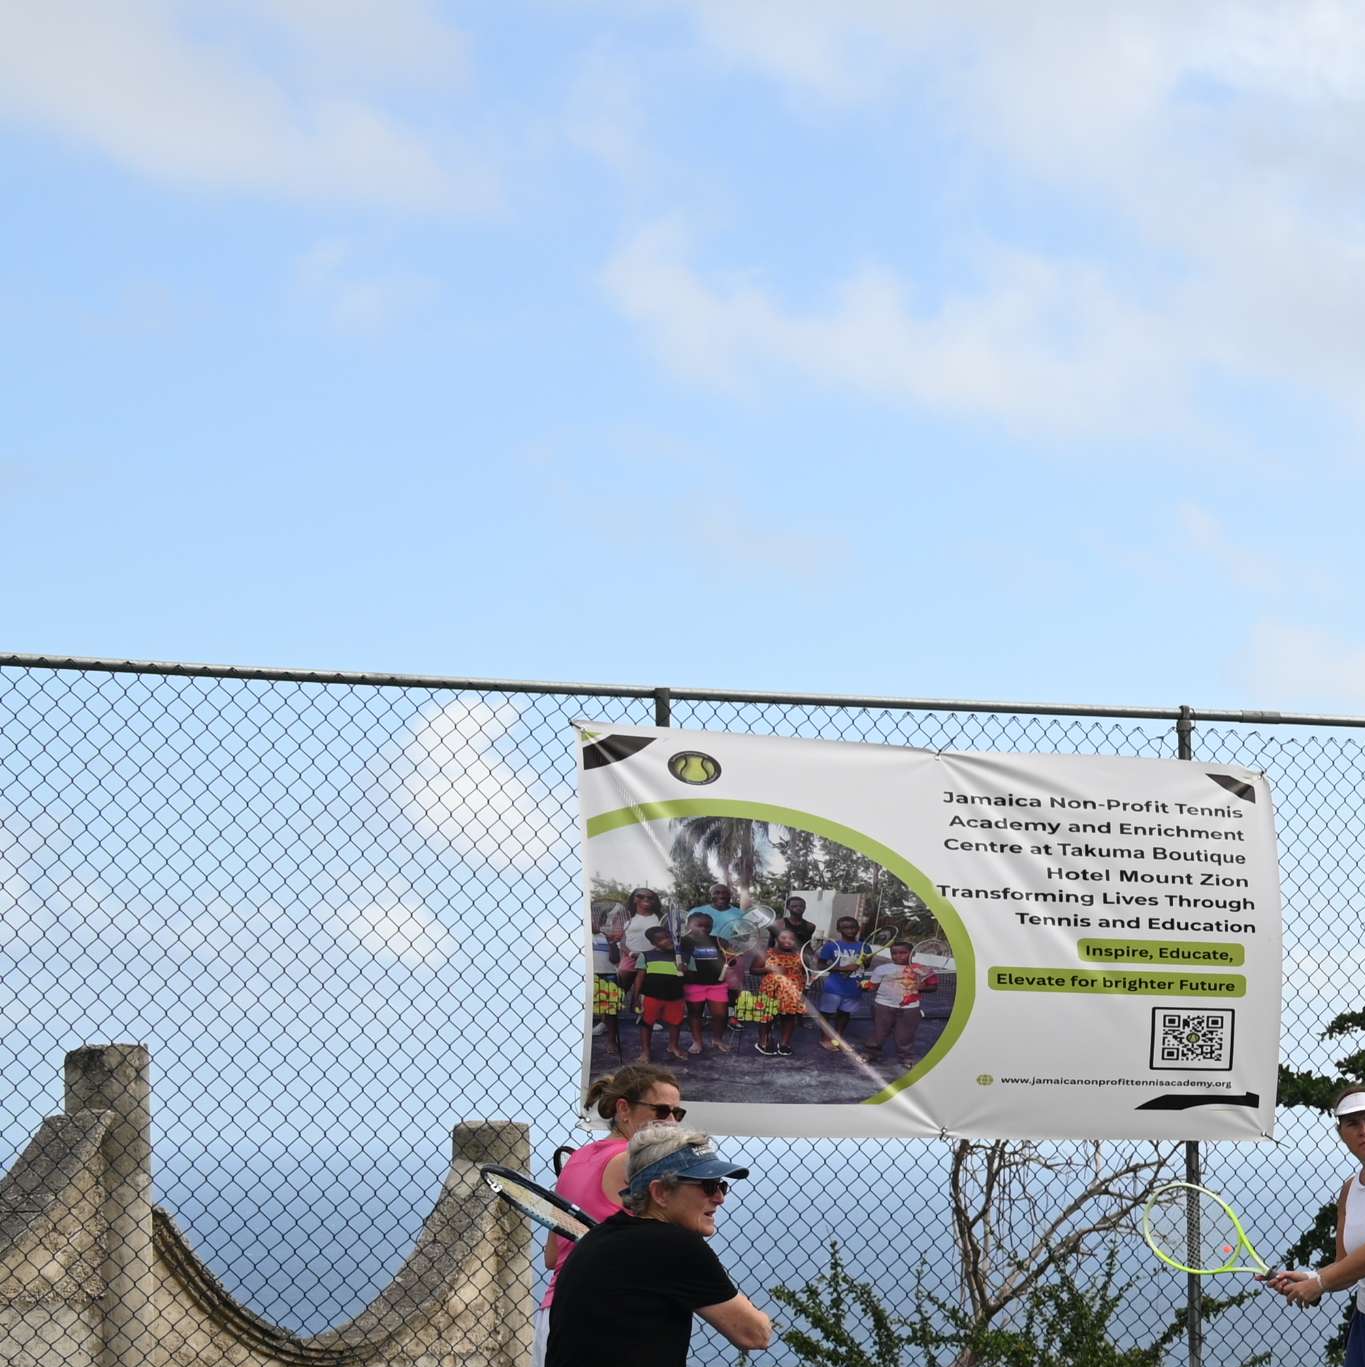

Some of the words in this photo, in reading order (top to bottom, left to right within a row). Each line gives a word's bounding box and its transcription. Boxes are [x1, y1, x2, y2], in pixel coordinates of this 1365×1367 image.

[943, 791, 1042, 808] Jamaica
[1050, 796, 1170, 815] Non-Profit
[1174, 802, 1244, 819] Tennis
[948, 815, 1062, 836] Academy
[1068, 821, 1112, 835] and
[1119, 822, 1245, 842] Enrichment
[943, 838, 1024, 855] Centre
[1030, 843, 1054, 857] at
[1056, 842, 1145, 860] Takuma
[1152, 846, 1247, 867] Boutique
[1046, 866, 1111, 882] Hotel
[1119, 869, 1194, 886] Mount
[1199, 872, 1249, 888] Zion
[935, 884, 1095, 907] Transforming
[1102, 891, 1160, 907] Lives
[1163, 894, 1256, 913] Through
[1014, 911, 1092, 928] Tennis
[1097, 916, 1141, 930] and
[1147, 917, 1256, 934] Education
[1085, 944, 1154, 961] Inspire,
[1159, 947, 1234, 962] Educate,
[996, 973, 1066, 988] Elevate
[1070, 975, 1097, 989] for
[1102, 976, 1175, 992] brighter
[1179, 978, 1235, 992] Future
[1000, 1076, 1232, 1090] www.jamaicanonprofittennisacademy.org
